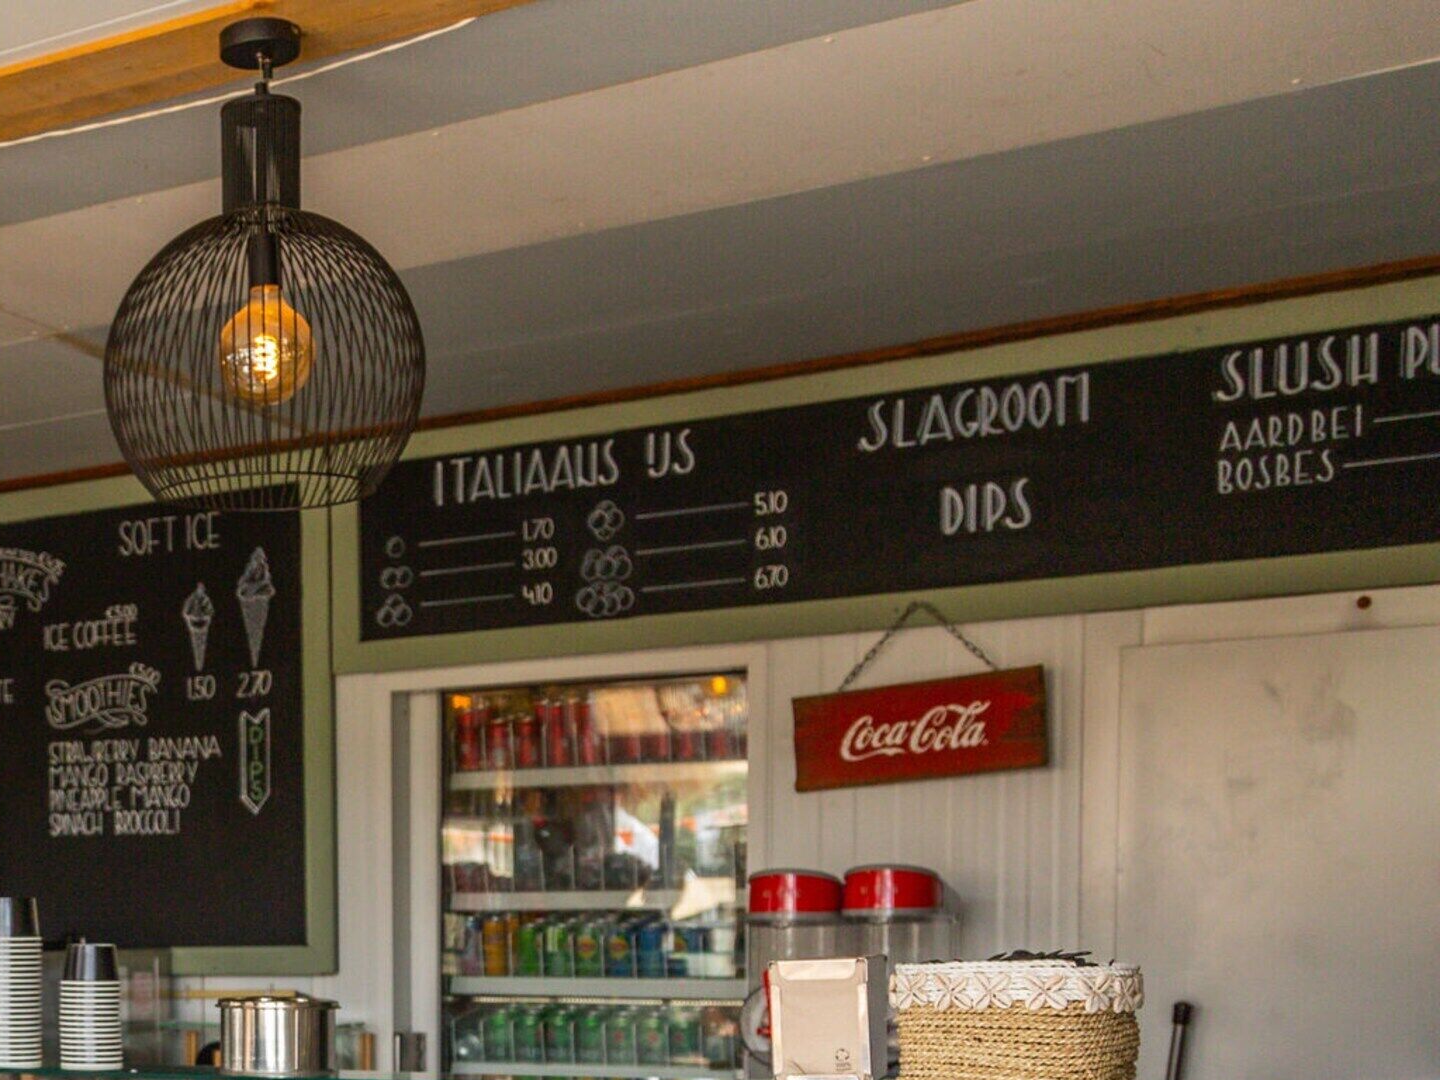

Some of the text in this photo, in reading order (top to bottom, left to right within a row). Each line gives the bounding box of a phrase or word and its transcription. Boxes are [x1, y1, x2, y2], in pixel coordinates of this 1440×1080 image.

[1213, 333, 1378, 401] SLUSH
[859, 371, 1090, 452] SLAGROOM
[1220, 404, 1363, 452] AARDBEI
[1216, 449, 1336, 494] BOSBES
[940, 477, 1032, 535] DIPS
[118, 510, 221, 557] SOFT ICE
[44, 618, 138, 652] ICE COFFEE
[46, 678, 152, 728] SMOOTHIES
[147, 733, 224, 761] BANANA
[840, 700, 991, 763] Coca-Cola
[48, 762, 110, 791] MANGO
[129, 782, 192, 811] MANGO
